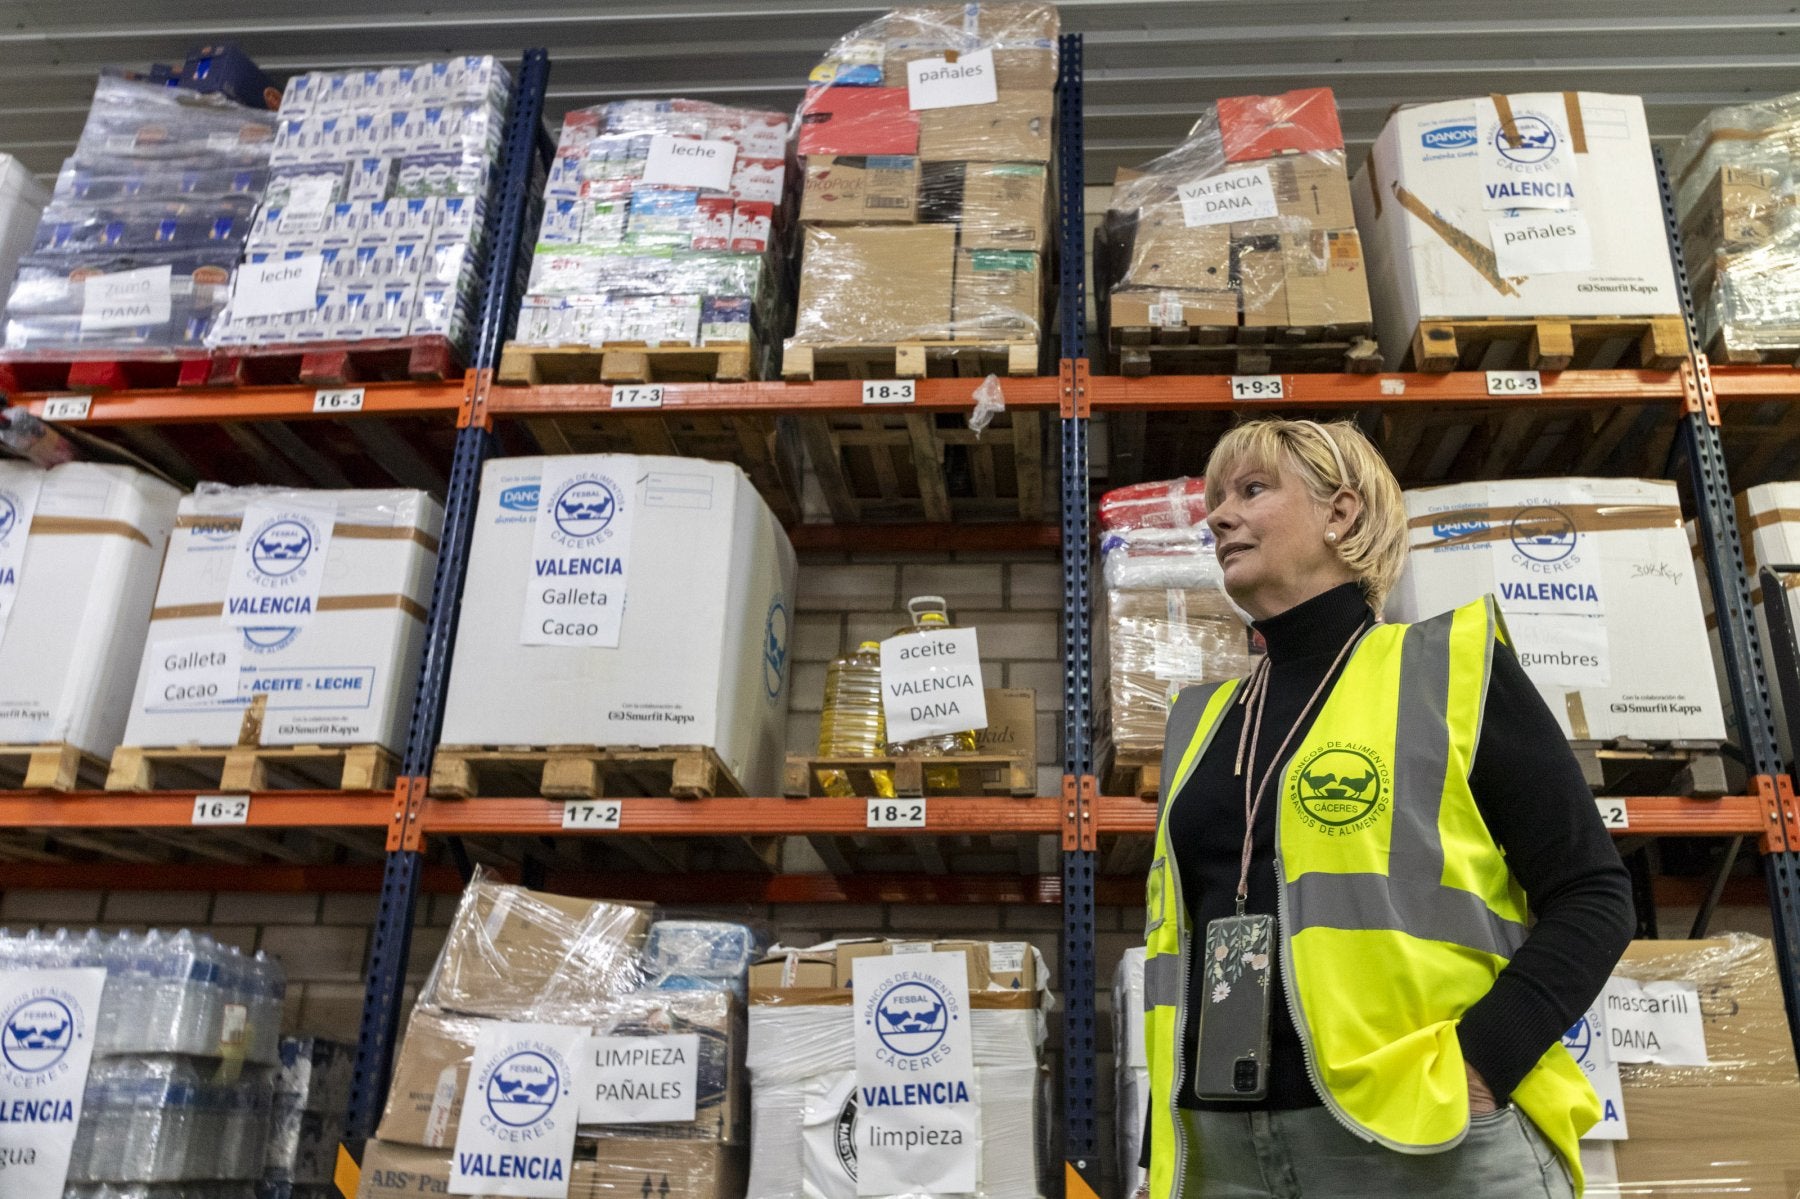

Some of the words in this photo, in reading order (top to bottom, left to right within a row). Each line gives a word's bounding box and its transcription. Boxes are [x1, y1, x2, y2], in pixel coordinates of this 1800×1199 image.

[919, 64, 983, 84] pañales
[671, 143, 716, 158] leche
[1486, 181, 1575, 199] VALENCIA
[1206, 196, 1252, 212] DANA
[1504, 224, 1577, 245] pañales
[261, 267, 302, 283] leche
[865, 385, 913, 400] 18-3
[1491, 377, 1538, 391] 20-3
[318, 394, 361, 408] 16-3
[615, 389, 661, 403] 17-3
[504, 490, 540, 503] DANO
[191, 522, 241, 535] DANON
[535, 557, 623, 576] VALENCIA
[542, 588, 607, 606] Galleta
[1500, 583, 1599, 602] VALENCIA
[229, 596, 312, 614] VALENCIA
[542, 619, 599, 636] Cacao
[899, 640, 956, 660] aceite
[164, 650, 226, 671] Galleta
[1518, 651, 1600, 668] gumbres
[164, 683, 218, 701] Cacao
[252, 677, 304, 692] ACEITE
[314, 676, 363, 690] LECHE
[890, 674, 974, 697] VALENCIA
[625, 711, 663, 721] Smurfit
[665, 712, 695, 724] Kappa
[910, 701, 960, 722] DANA
[1628, 702, 1668, 713] Smurfit
[1669, 703, 1702, 715] Kappa
[1291, 746, 1324, 782] BANCOS
[1327, 741, 1342, 749] DE
[1345, 742, 1390, 785] ALIMENTOS
[197, 803, 246, 819] 16-2
[566, 806, 618, 822] 17-2
[870, 805, 923, 821] 18-2
[1290, 793, 1316, 828] BANCOS
[1319, 824, 1335, 837] DE
[1339, 796, 1390, 837] ALIMENTOS
[1601, 808, 1625, 823] -2
[864, 978, 893, 1018] BANCOS
[894, 971, 909, 982] DE
[911, 971, 959, 1013] ALIMENTOS
[893, 995, 928, 1004] FESBAL
[1608, 994, 1688, 1014] mascarill
[1612, 1028, 1661, 1050] DANA
[595, 1048, 685, 1067] LIMPIEZA
[596, 1079, 681, 1101] PAÑALES
[862, 1080, 970, 1107] VALENCIA
[0, 1099, 74, 1123] LENCIA
[870, 1125, 963, 1151] limpieza
[0, 1147, 36, 1170] gua
[459, 1152, 563, 1181] VALENCIA
